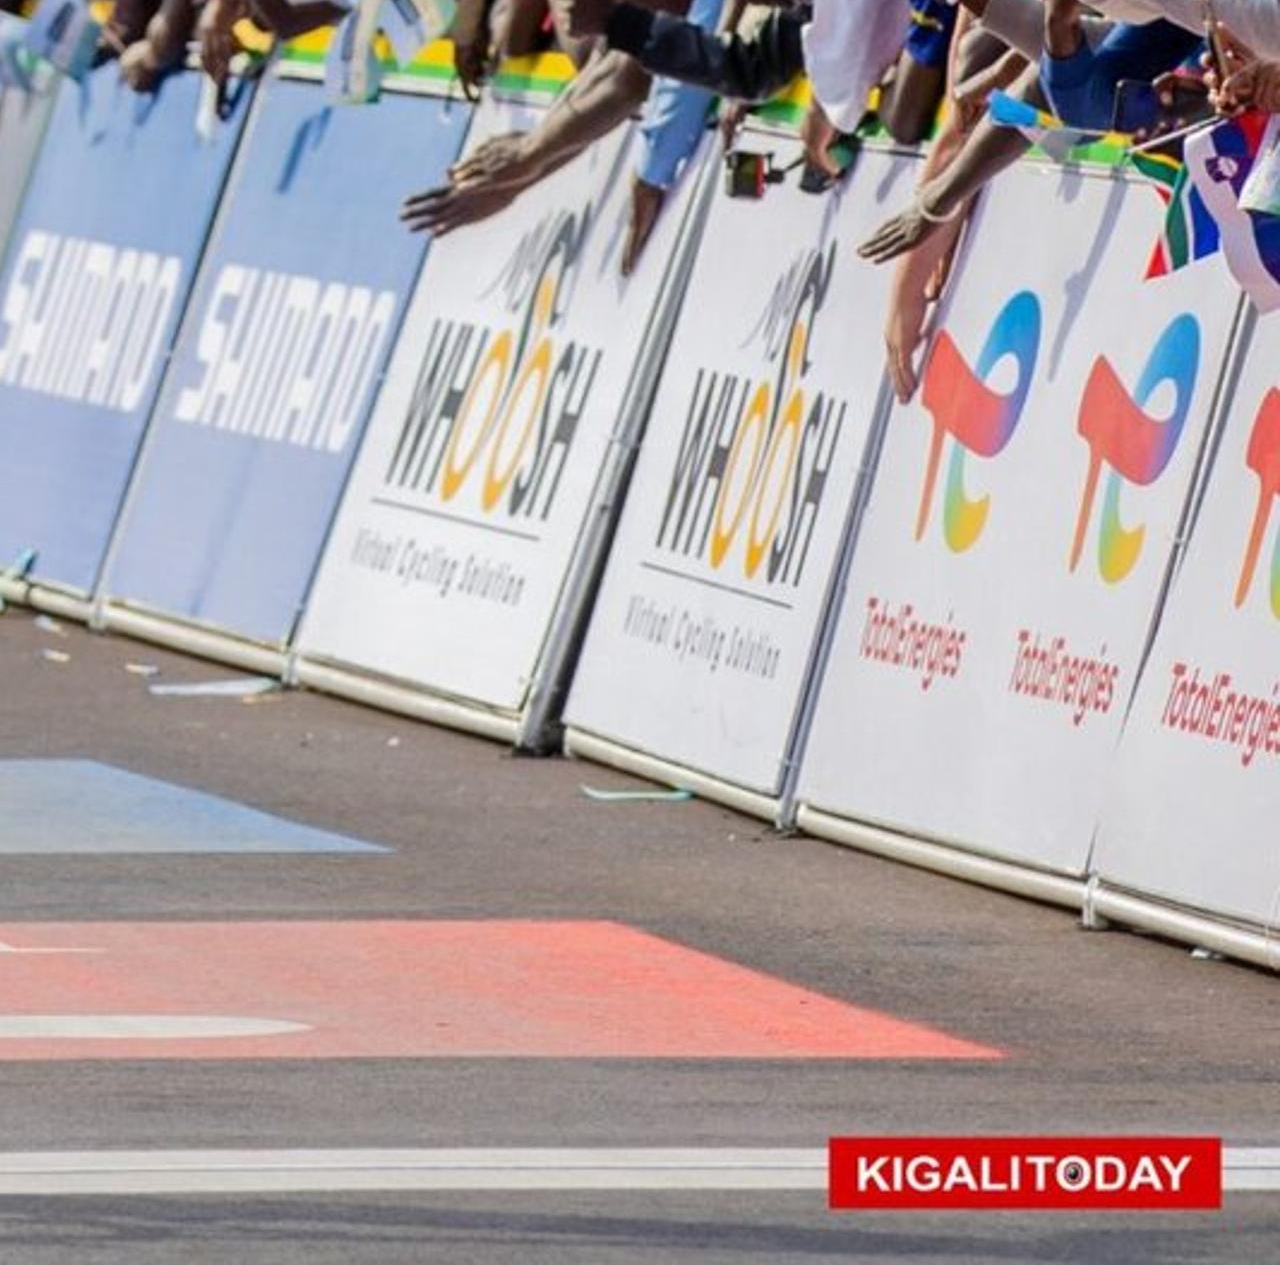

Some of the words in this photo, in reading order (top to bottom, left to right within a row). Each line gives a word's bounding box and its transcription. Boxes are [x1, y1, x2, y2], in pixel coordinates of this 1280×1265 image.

[174, 264, 397, 453] SHIMANO
[385, 318, 603, 522] WHOOSH
[656, 368, 848, 588] WHOOSH
[858, 596, 967, 691] TotalEnergies
[1008, 628, 1120, 727] TotalEnergies
